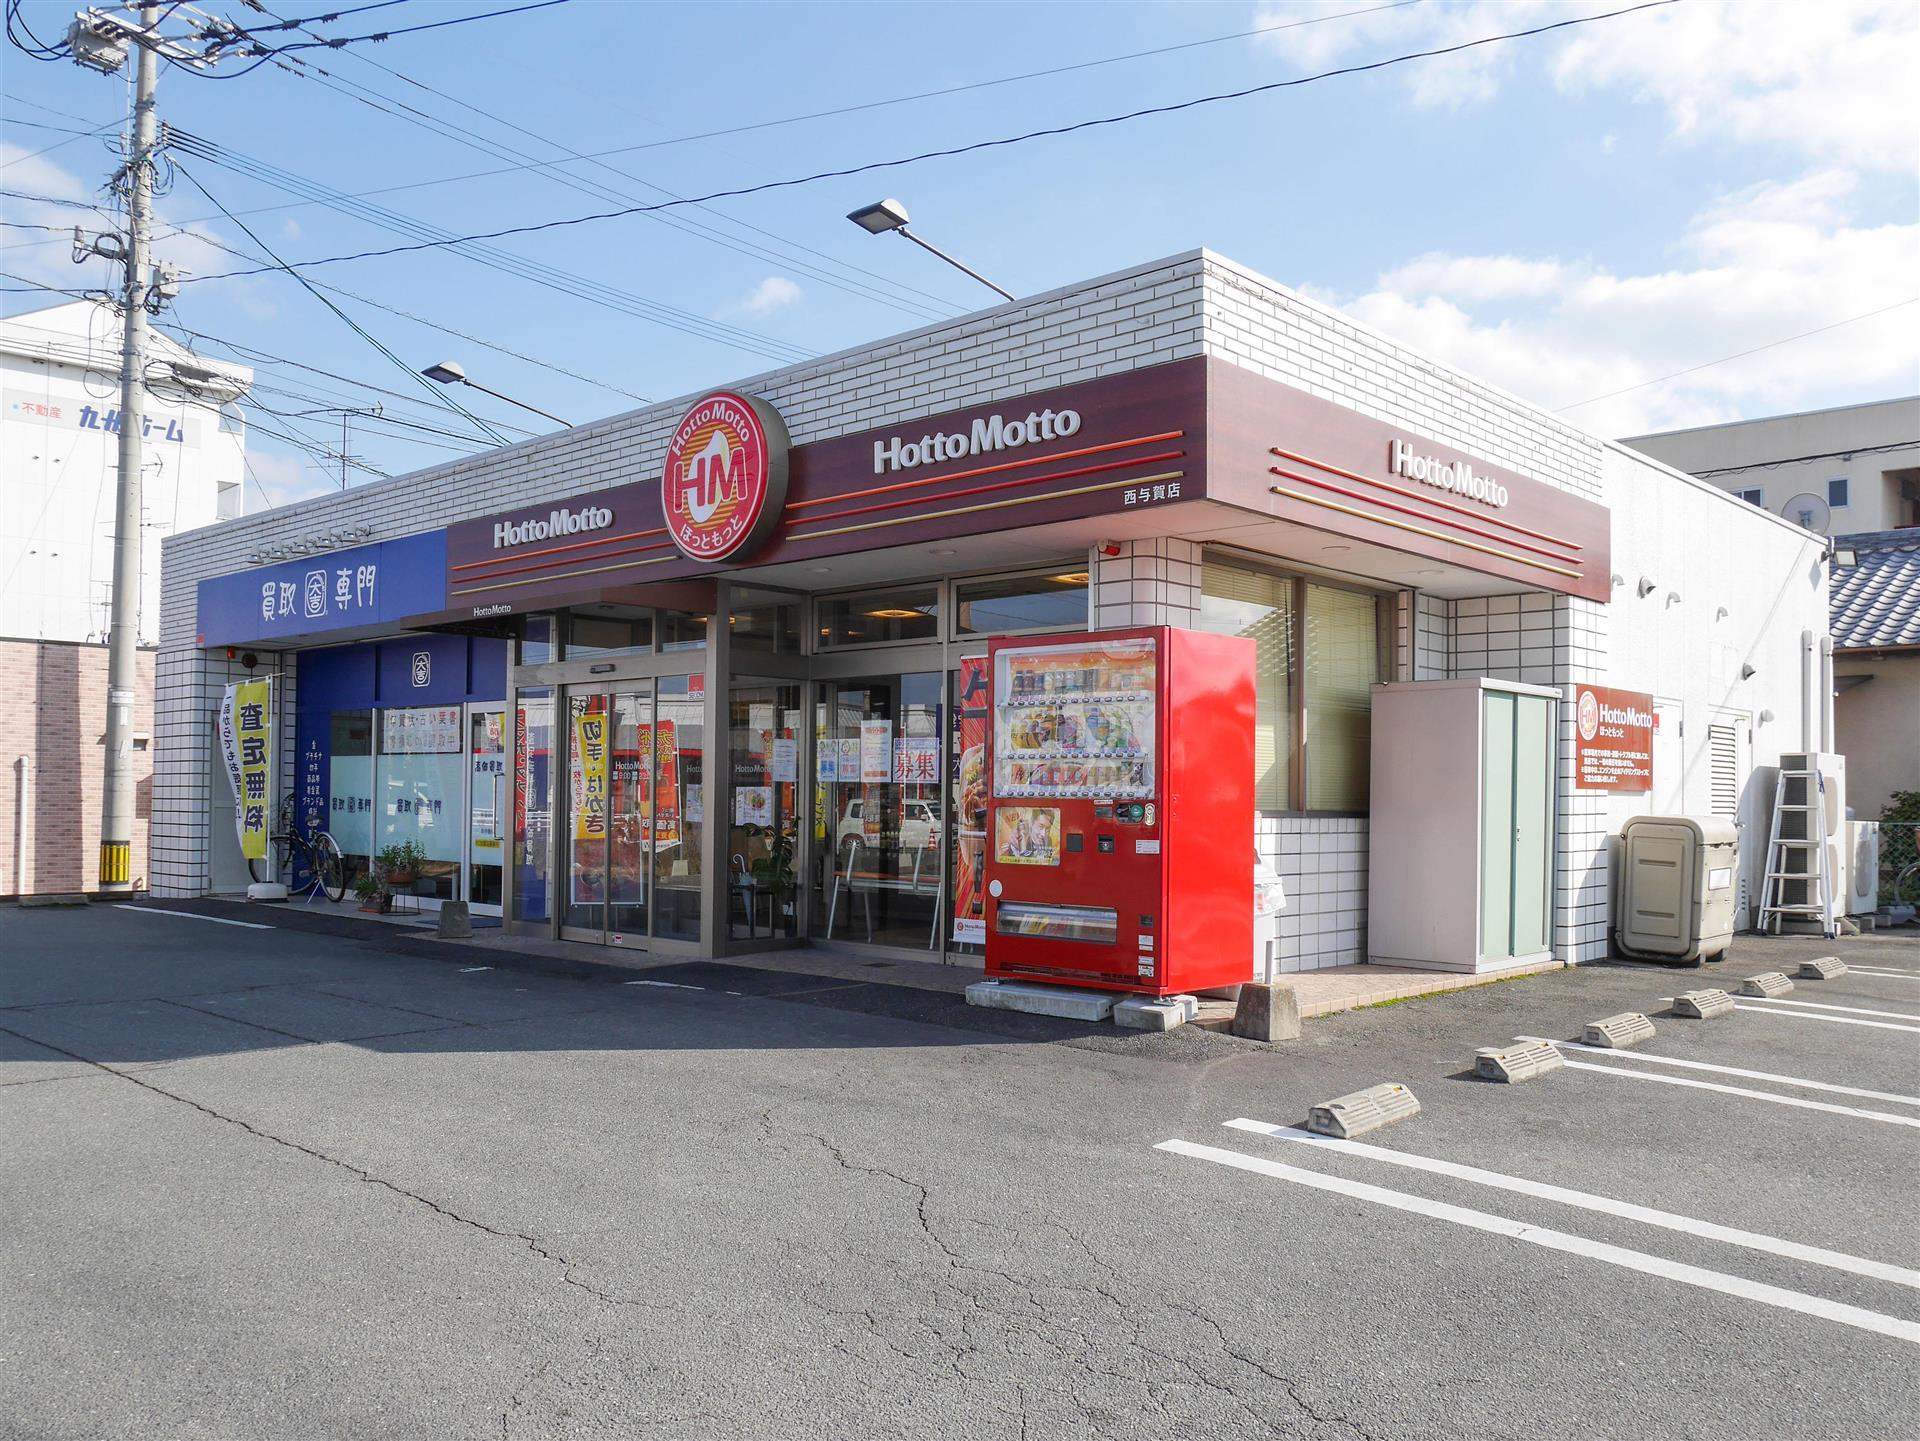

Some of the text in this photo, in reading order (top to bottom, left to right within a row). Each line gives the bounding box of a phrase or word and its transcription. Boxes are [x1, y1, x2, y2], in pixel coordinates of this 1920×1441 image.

[22, 402, 62, 419] 不動産
[672, 402, 750, 457] HottoMotto
[873, 408, 1082, 475] HottoMotto
[673, 446, 748, 514] HM
[1390, 438, 1509, 508] HottoMotto
[1124, 482, 1181, 505] 西与賀店
[494, 506, 613, 549] HottoMotto
[680, 514, 743, 549] ほっともっと
[262, 581, 297, 621] 買取
[335, 564, 376, 610] 専門
[473, 604, 512, 617] HottoMotto
[1599, 703, 1653, 728] HottoMotto
[1599, 726, 1625, 738] ほっともっと
[894, 750, 935, 780] 募集
